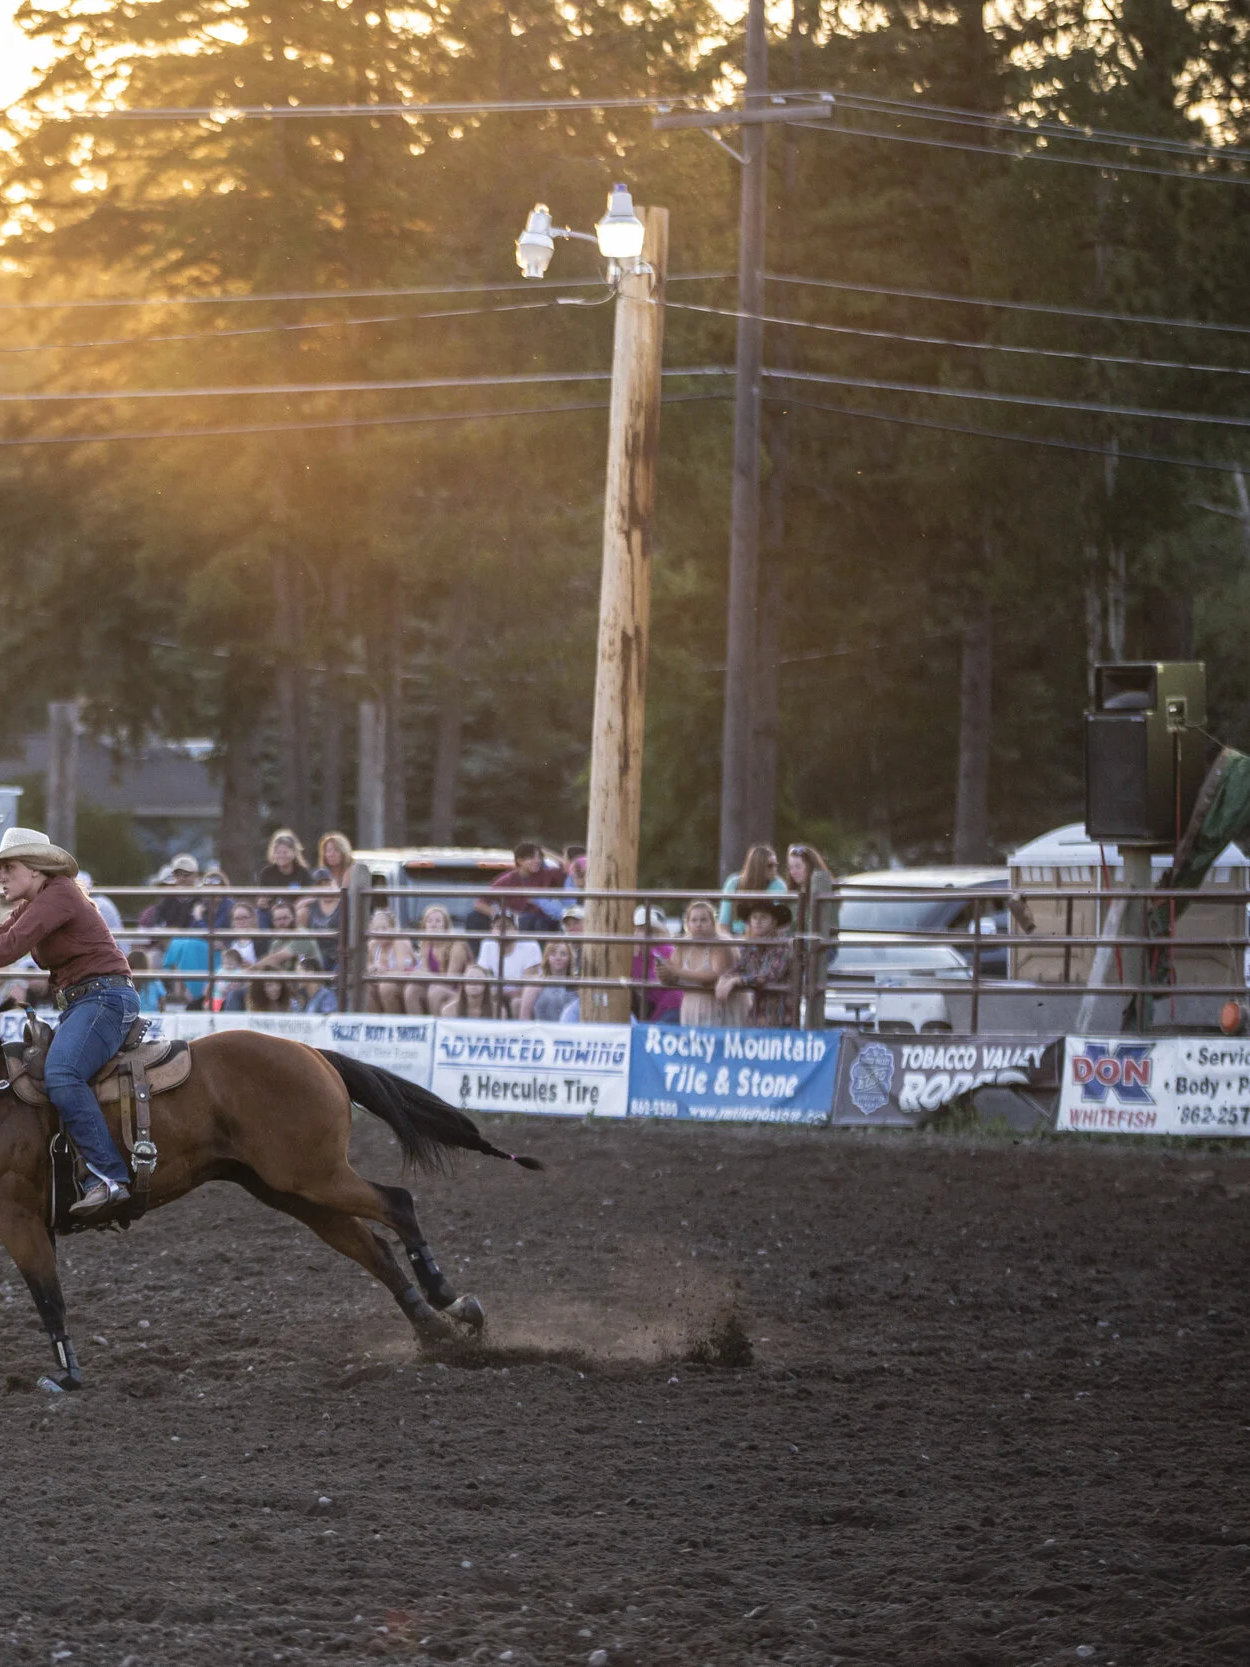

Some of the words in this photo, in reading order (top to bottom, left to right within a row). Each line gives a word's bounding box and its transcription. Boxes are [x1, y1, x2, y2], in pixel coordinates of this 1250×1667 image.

[440, 1035, 545, 1062] ADVANCED
[553, 1039, 626, 1067] TOWING
[645, 1026, 715, 1063] Rocky
[724, 1032, 826, 1063] Mountain
[901, 1044, 977, 1070] TOBACCO
[981, 1045, 1047, 1069] VALLEY
[664, 1062, 708, 1095] Tile
[713, 1065, 730, 1096] &
[736, 1067, 798, 1099] Stone
[1072, 1056, 1153, 1086] DON
[459, 1074, 471, 1097] &
[478, 1075, 558, 1102] Hercules
[563, 1079, 600, 1105] Tire
[1175, 1075, 1219, 1099] Body
[1238, 1075, 1250, 1095] P
[1069, 1108, 1158, 1128] WHITEFISH
